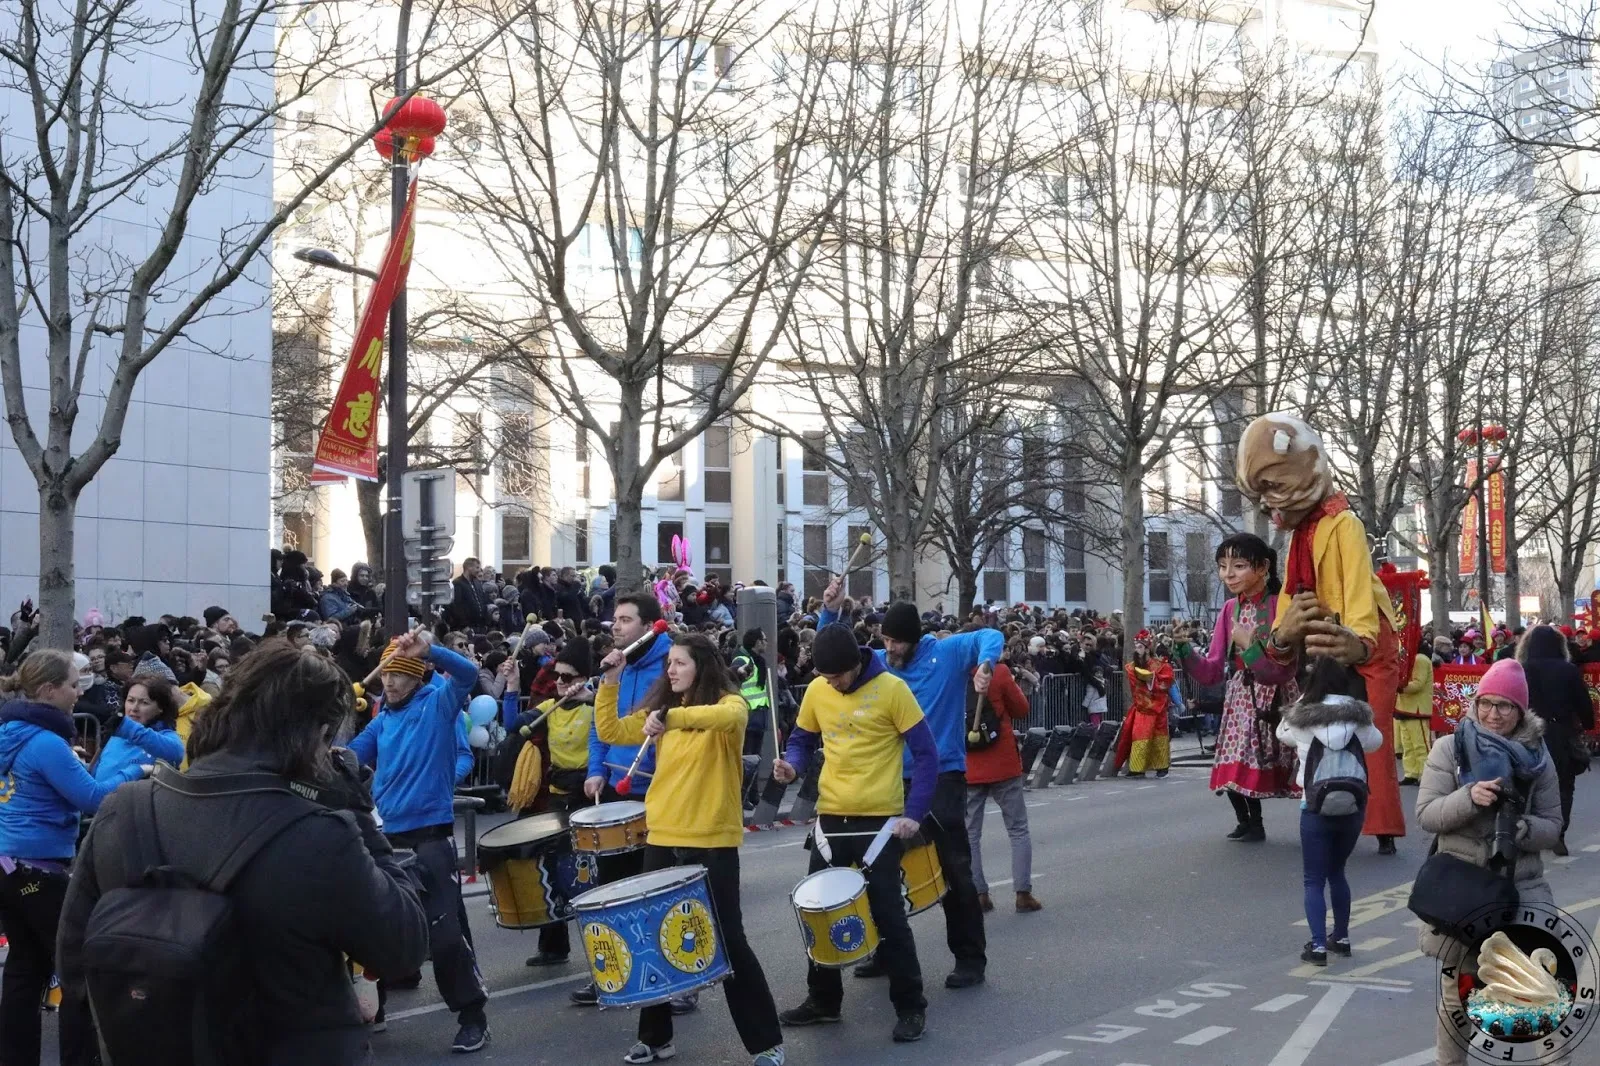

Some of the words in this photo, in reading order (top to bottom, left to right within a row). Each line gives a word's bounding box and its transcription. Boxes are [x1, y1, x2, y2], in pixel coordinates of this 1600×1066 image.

[1491, 472, 1502, 510] BONNE
[1445, 674, 1482, 683] ASSOCIATIO
[290, 781, 319, 801] Nikon
